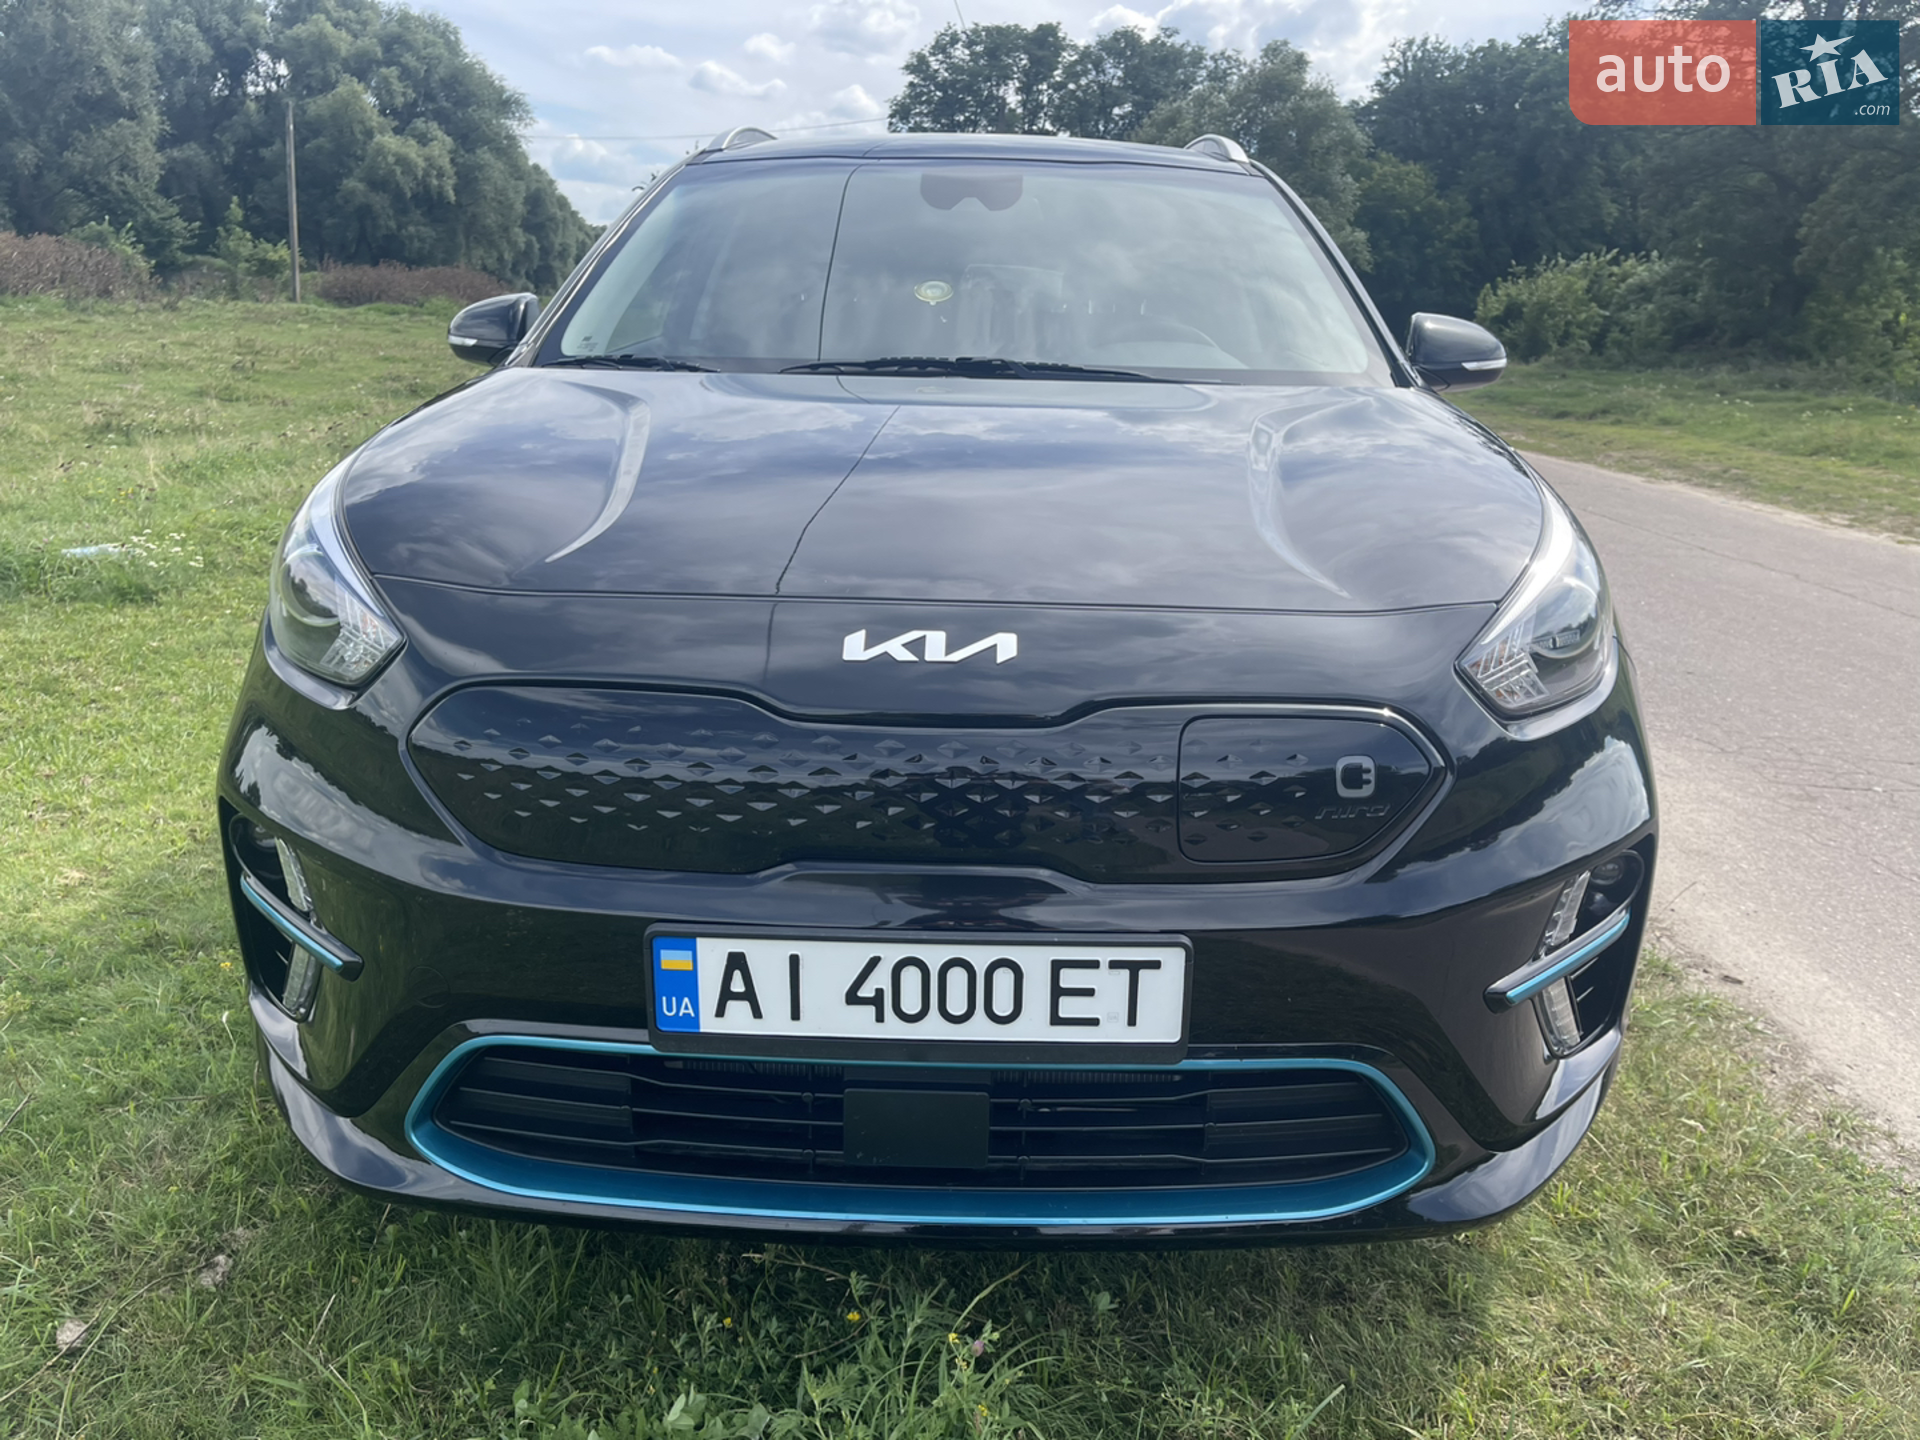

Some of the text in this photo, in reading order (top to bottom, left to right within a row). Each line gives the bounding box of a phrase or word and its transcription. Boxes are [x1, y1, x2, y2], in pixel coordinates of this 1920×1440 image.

[842, 629, 1017, 664] KIA
[714, 951, 1162, 1027] AI 4000 ET
[661, 996, 695, 1018] UA
